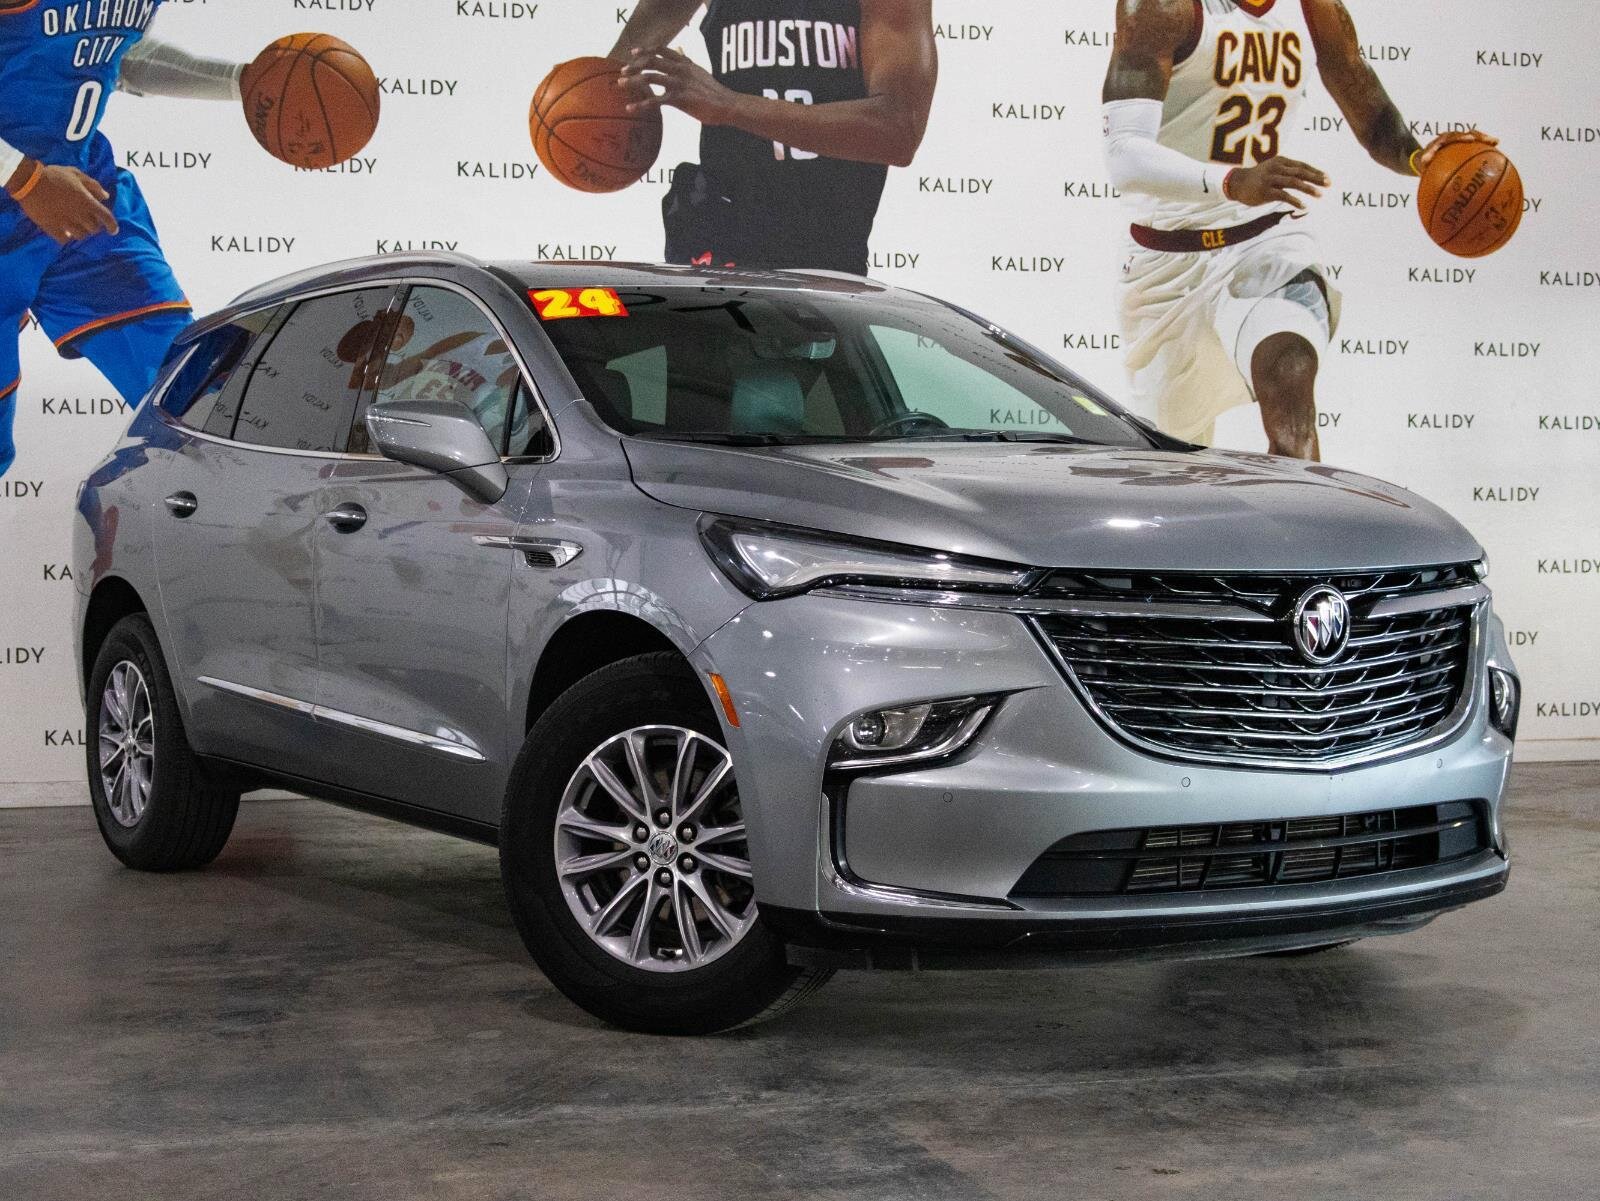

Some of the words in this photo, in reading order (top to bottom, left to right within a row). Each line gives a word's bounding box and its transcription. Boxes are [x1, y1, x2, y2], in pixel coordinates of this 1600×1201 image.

[294, 0, 374, 11] KALIDY
[457, 0, 538, 19] KALIDY
[43, 0, 154, 36] OKLAHOM
[933, 24, 994, 41] ALIDY
[1064, 30, 1117, 47] KALI
[73, 36, 124, 67] CITY
[721, 20, 857, 74] HOUSTON
[1214, 31, 1302, 89] CAVS
[1477, 51, 1542, 67] KALIDY
[378, 77, 458, 97] KALIDY
[66, 80, 102, 142] 0
[993, 103, 1065, 120] KALIDY
[1210, 94, 1287, 165] 23
[127, 151, 211, 169] KALIDY
[458, 161, 538, 179] KALIDY
[920, 177, 992, 193] KALIDY
[1343, 192, 1409, 208] KALIDY
[212, 236, 295, 253] KALIDY
[1202, 231, 1224, 248] CLE
[538, 244, 617, 261] KALIDY
[866, 252, 920, 269] LIDY
[992, 256, 1064, 272] KALIDY
[1409, 268, 1475, 283] KALIDY
[533, 288, 620, 318] 24
[1063, 333, 1120, 350] KALID
[1341, 340, 1408, 354] KALIDY
[1475, 342, 1540, 357] KALIDY
[43, 398, 128, 415] KALIDY
[990, 408, 1061, 425] KALID
[1408, 414, 1474, 428] KALIDY
[0, 481, 43, 497] IDY
[1474, 487, 1539, 501] KALIDY
[0, 647, 45, 664] IDY
[1537, 702, 1600, 717] KALIDY
